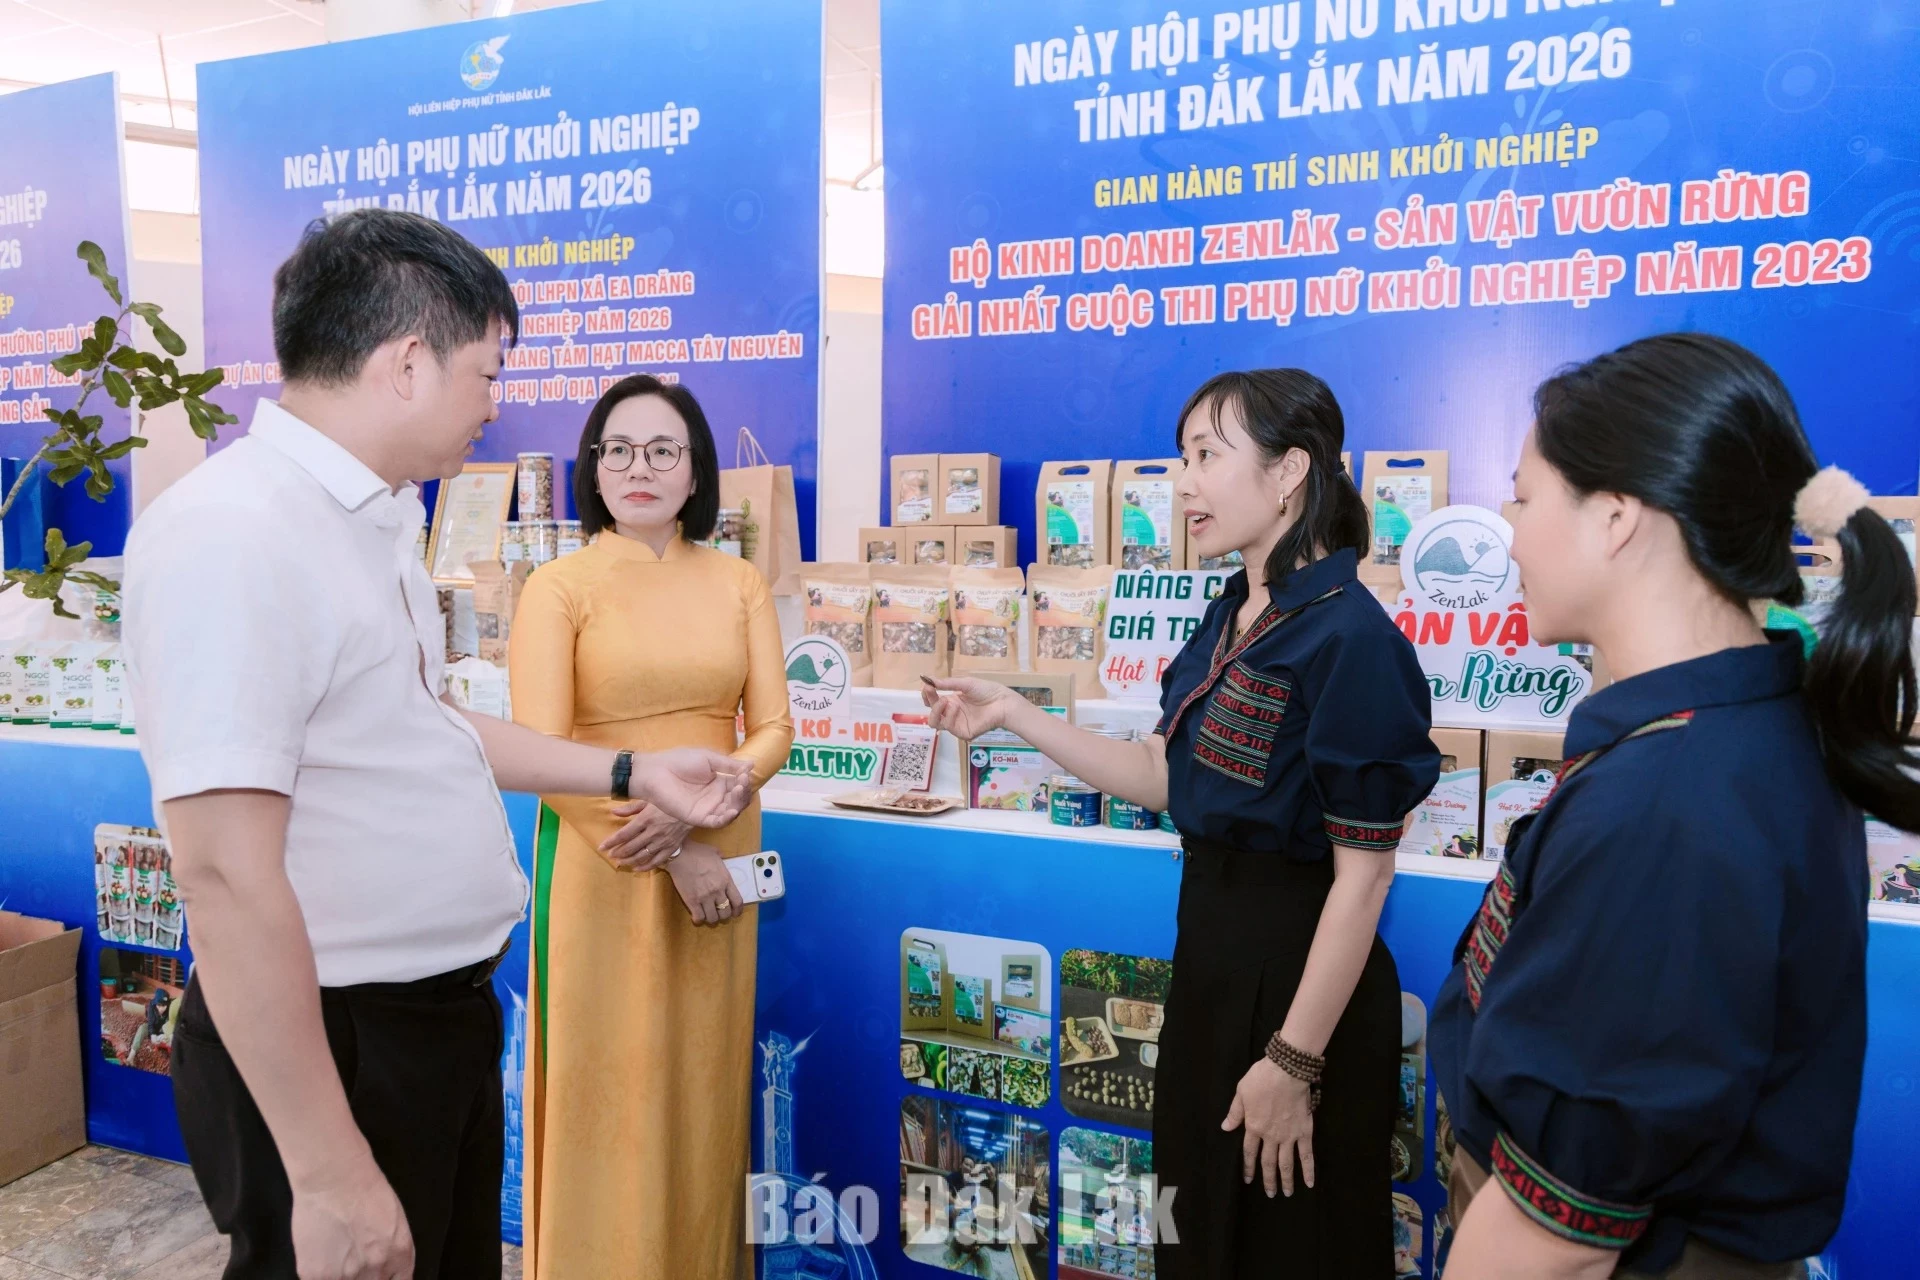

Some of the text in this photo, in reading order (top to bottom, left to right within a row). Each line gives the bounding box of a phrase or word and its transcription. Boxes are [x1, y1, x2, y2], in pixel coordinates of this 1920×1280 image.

[1013, 25, 1120, 87] NGÀY
[1130, 11, 1200, 76] HỘI
[1213, 0, 1301, 61] PHỤ
[1074, 27, 1632, 142] TỈNH ĐẮK LẮK NĂM 2026
[408, 103, 424, 117] HỘI
[424, 100, 441, 114] LIÊN
[442, 98, 461, 111] HIỆP
[462, 95, 480, 109] PHỤ
[284, 101, 701, 189] NGÀY HỘI PHỤ NỮ KHỞI NGHIỆP
[1094, 122, 1600, 208] GIAN HÀNG THÍ SINH KHỞI NGHIỆP
[447, 172, 498, 221] LẮK
[506, 170, 572, 216] NĂM
[579, 167, 653, 209] 2026
[950, 237, 992, 288] HỘ
[998, 237, 1074, 280] KINH
[1081, 227, 1194, 274] DOANH
[1201, 208, 1341, 264] ZENLĂK
[1375, 193, 1457, 250] SẢN
[1467, 189, 1545, 248] VẬT
[1553, 177, 1671, 237] VƯỜN
[1680, 168, 1811, 224] RỪNG
[515, 235, 559, 268] KHỞI
[564, 232, 636, 266] NGHIỆP
[536, 281, 579, 304] LHPN
[582, 274, 606, 302] XÃ
[609, 275, 632, 300] EA
[634, 268, 695, 299] DRĂNG
[912, 236, 1873, 340] GIẢI NHẤT CUỘC THI PHỤ NỮ KHỞI NGHIỆP NĂM 2023
[522, 309, 583, 340] NGHIỆP
[585, 306, 626, 335] NĂM
[628, 307, 672, 332] 2026
[506, 343, 552, 371] NÂNG
[553, 337, 589, 369] TẦM
[591, 344, 625, 370] HẠT
[627, 339, 689, 366] MACCA
[692, 333, 727, 362] TÂY
[728, 329, 804, 362] NGUYÊN
[13, 361, 46, 390] NĂM
[505, 378, 538, 407] PHỤ
[540, 375, 566, 402] NỮ
[567, 374, 598, 405] ĐỊA
[1115, 569, 1194, 600] NÂNG
[1109, 610, 1155, 640] GIÁ
[1394, 598, 1530, 656] ẢN VẬ
[1107, 656, 1147, 690] Hạt
[1458, 652, 1580, 714] Rừng
[801, 716, 832, 739] KƠ
[854, 722, 895, 744] NIA
